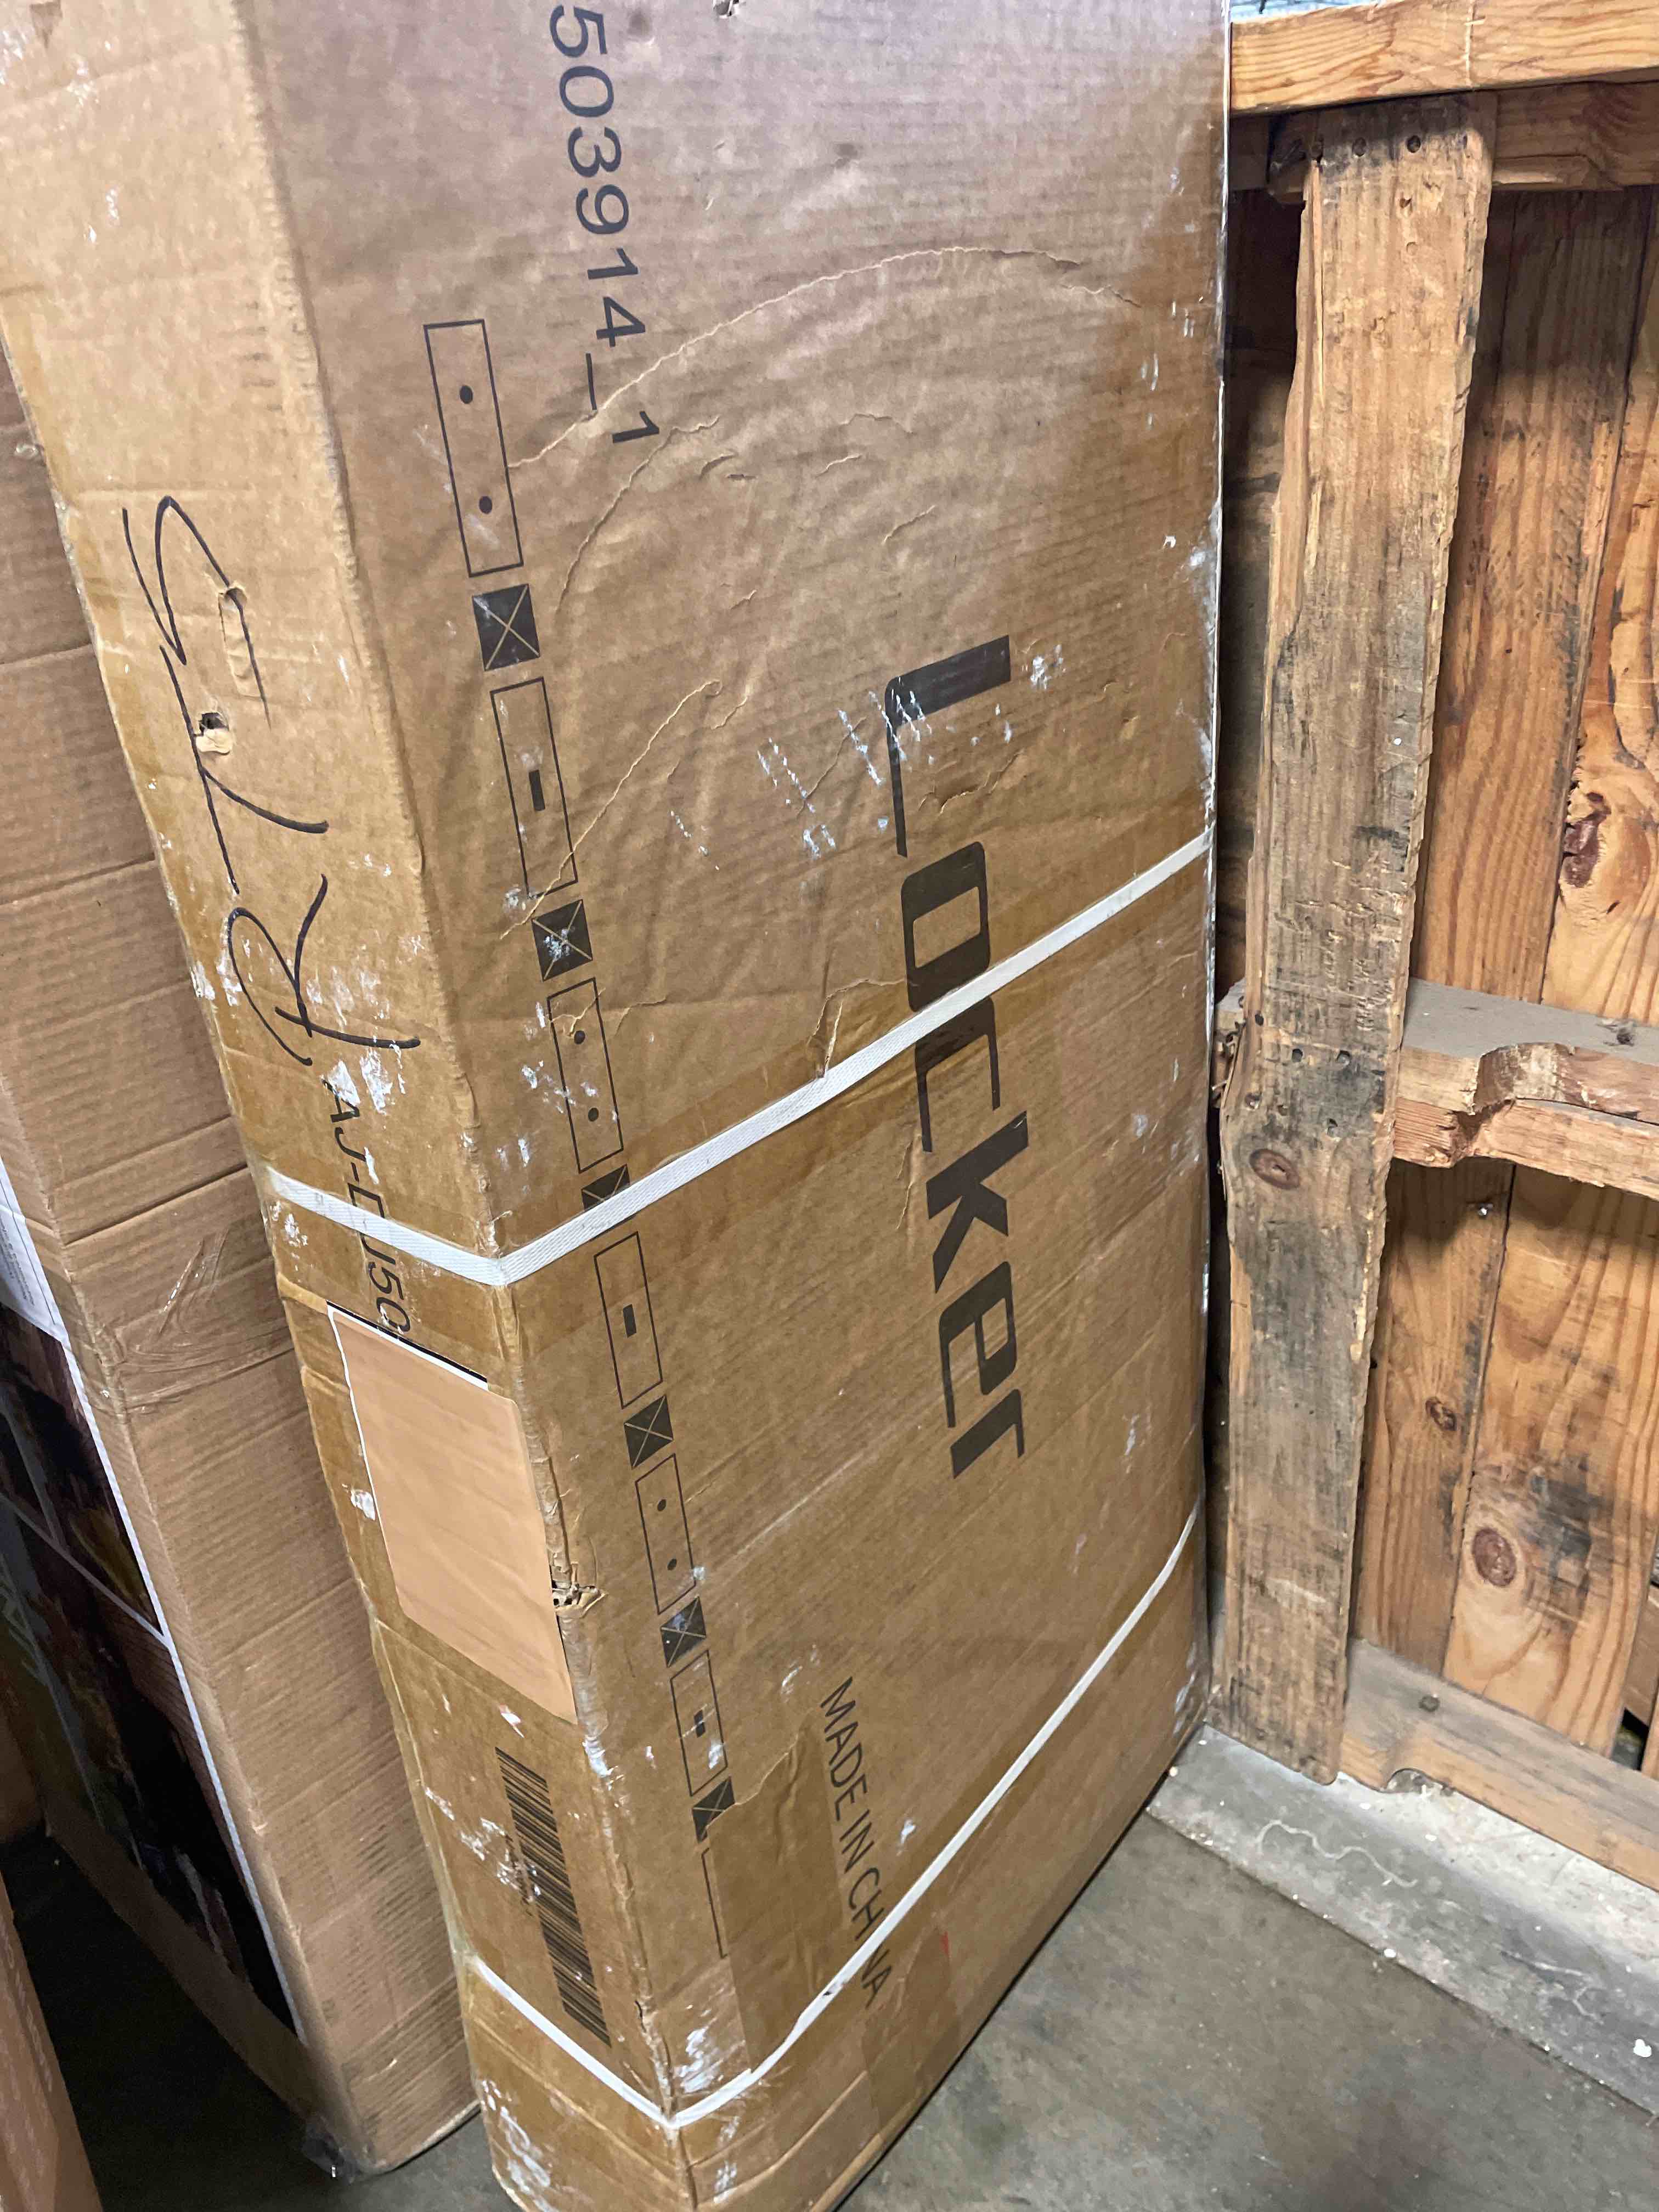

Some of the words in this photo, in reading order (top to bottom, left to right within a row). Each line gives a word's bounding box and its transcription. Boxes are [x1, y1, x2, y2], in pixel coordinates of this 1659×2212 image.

[885, 634, 1029, 1479] Locker
[821, 1675, 868, 1821] MADE
[839, 1808, 874, 1874] IN
[848, 1867, 892, 2009] CHNA
